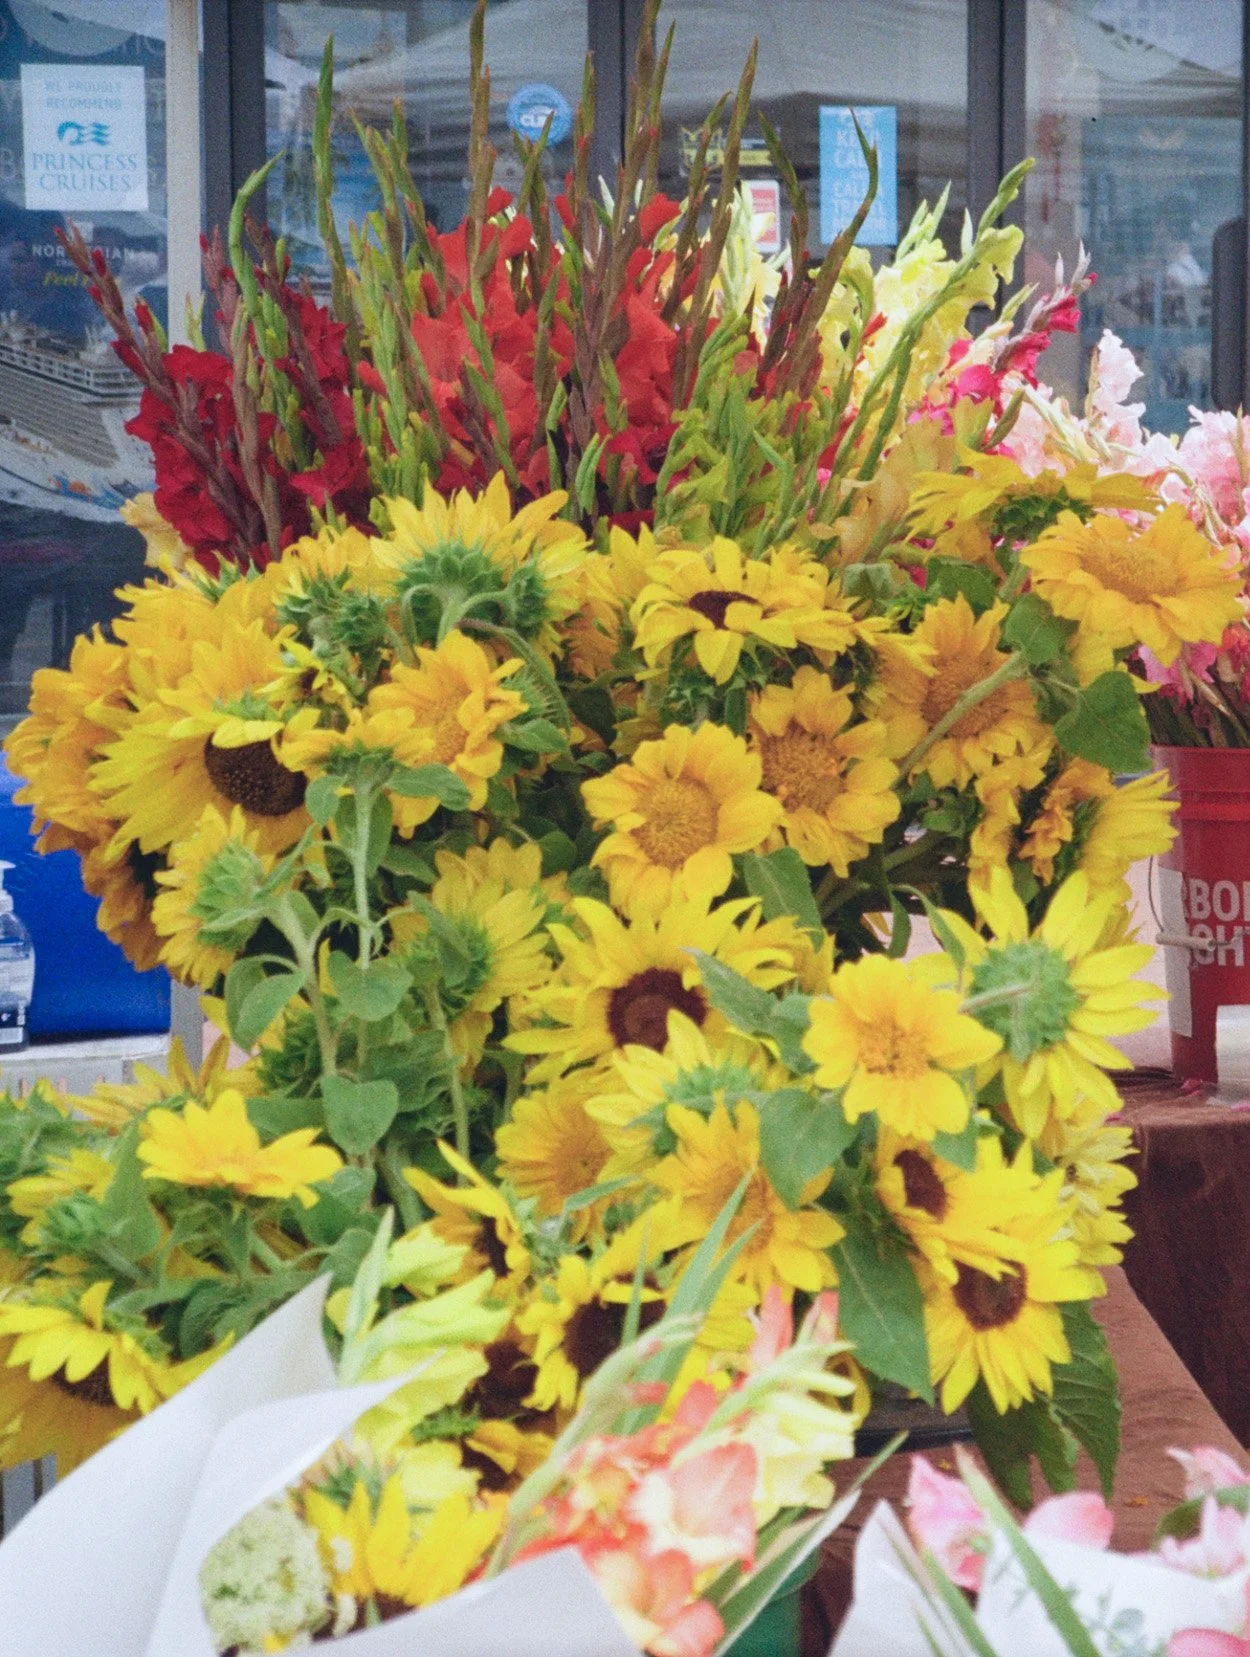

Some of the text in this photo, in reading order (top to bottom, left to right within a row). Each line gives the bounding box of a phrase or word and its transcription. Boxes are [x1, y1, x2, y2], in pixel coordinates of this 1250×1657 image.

[31, 153, 138, 171] PRINCESS
[39, 173, 132, 192] CRUISES
[32, 245, 135, 258] NORIAN
